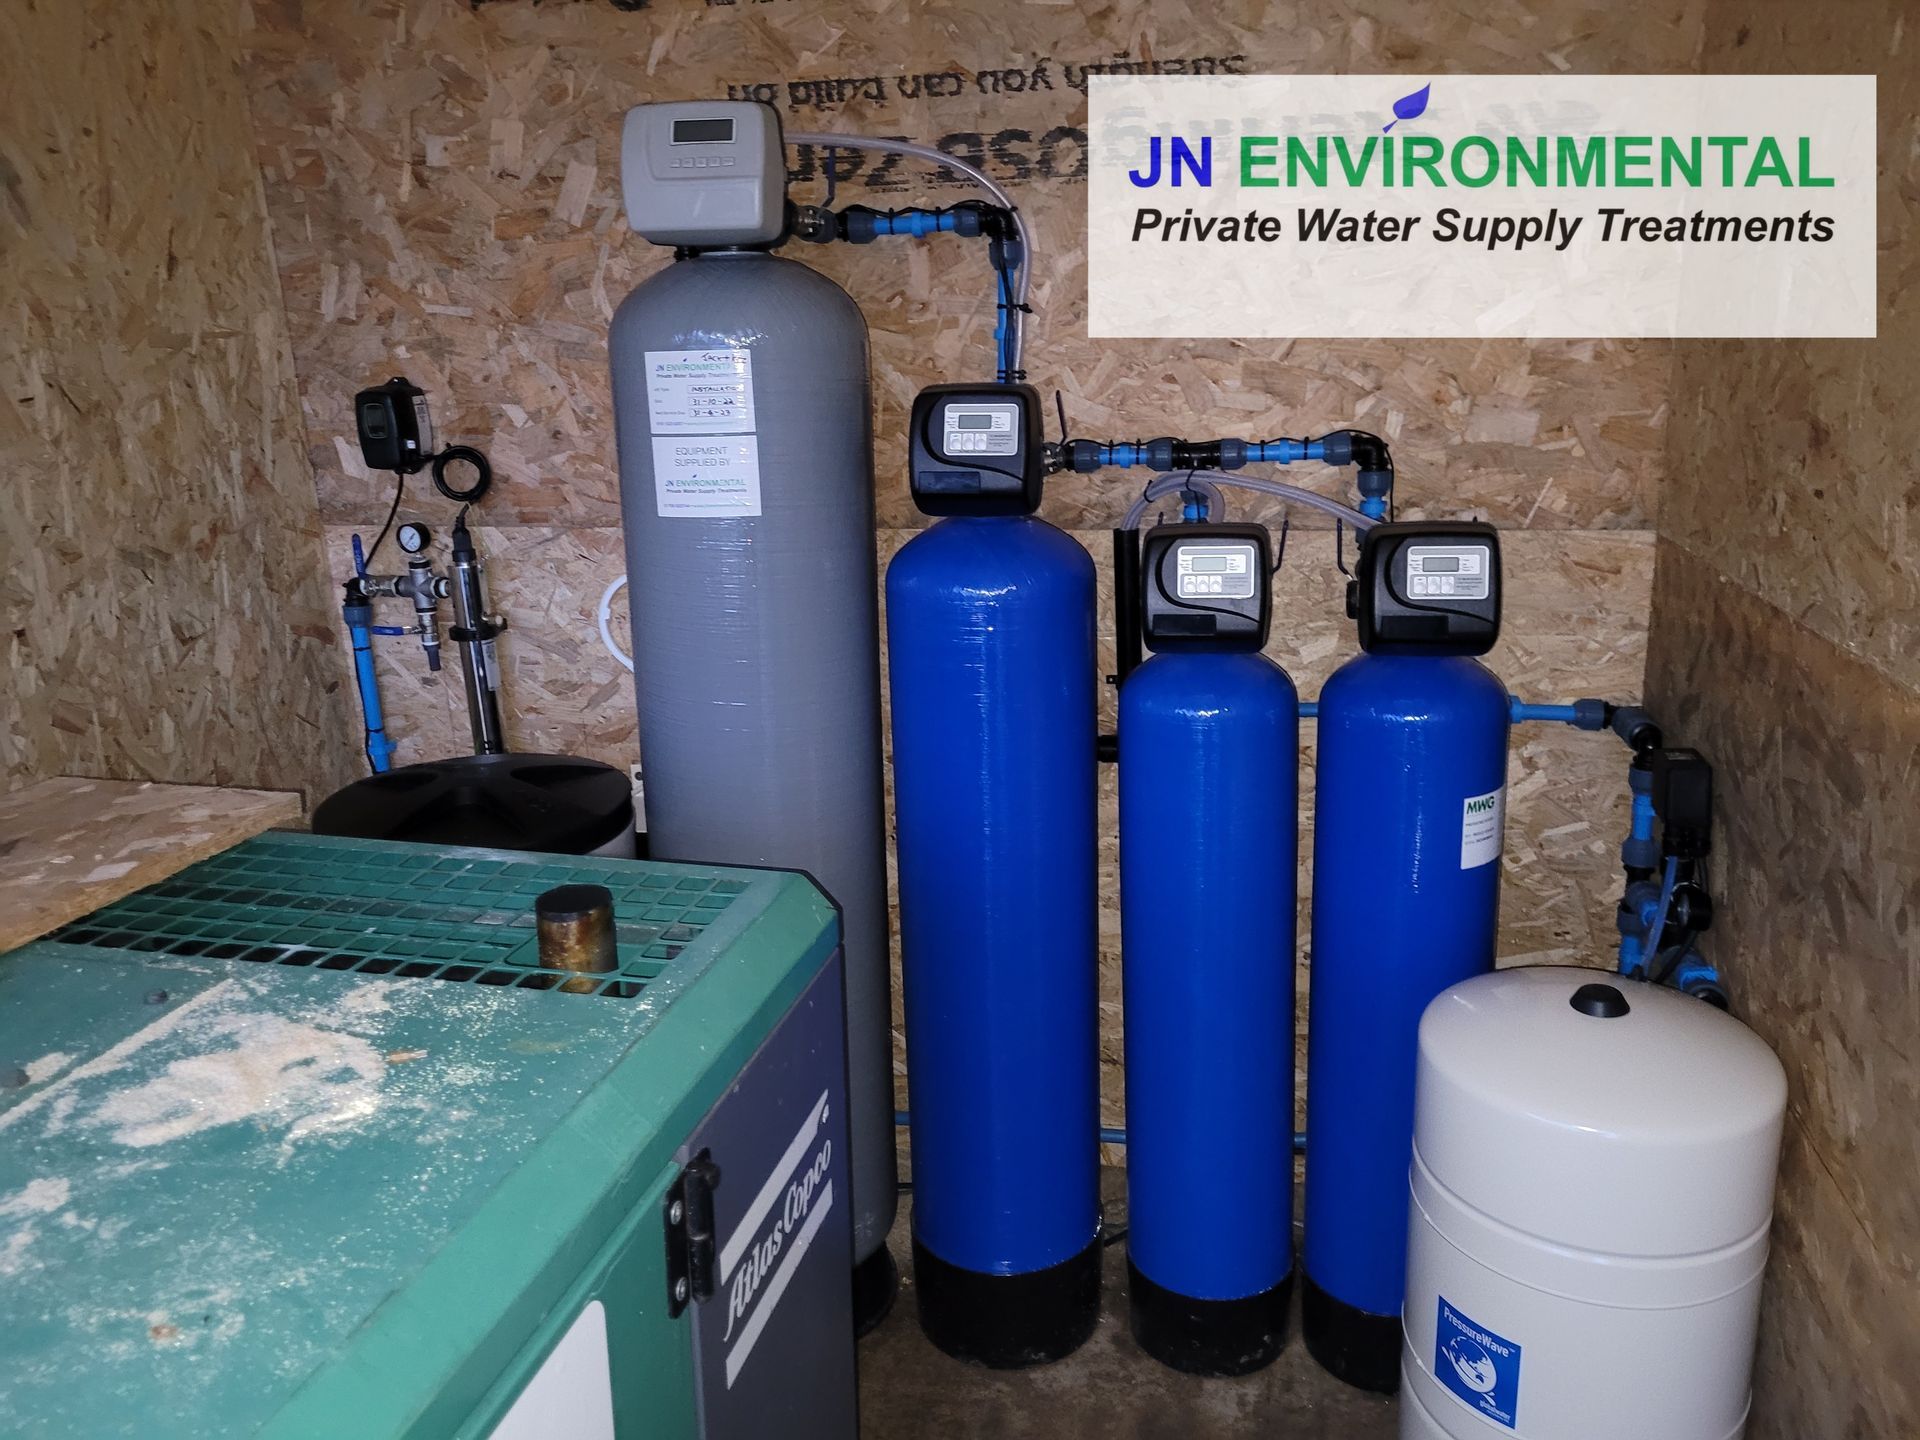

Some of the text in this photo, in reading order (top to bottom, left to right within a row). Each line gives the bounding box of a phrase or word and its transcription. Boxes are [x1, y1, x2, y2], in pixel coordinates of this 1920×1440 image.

[897, 71, 965, 100] can
[977, 57, 1056, 94] you
[727, 83, 780, 105] on
[787, 78, 888, 112] build
[674, 458, 731, 467] SUPPLIED BY
[675, 447, 728, 456] EQUIPMENT
[665, 478, 747, 487] JN ENVIRONMENTAL
[1466, 796, 1495, 814] MWG
[723, 1138, 832, 1341] Atlas Copco
[1443, 1306, 1509, 1358] PressureWave
